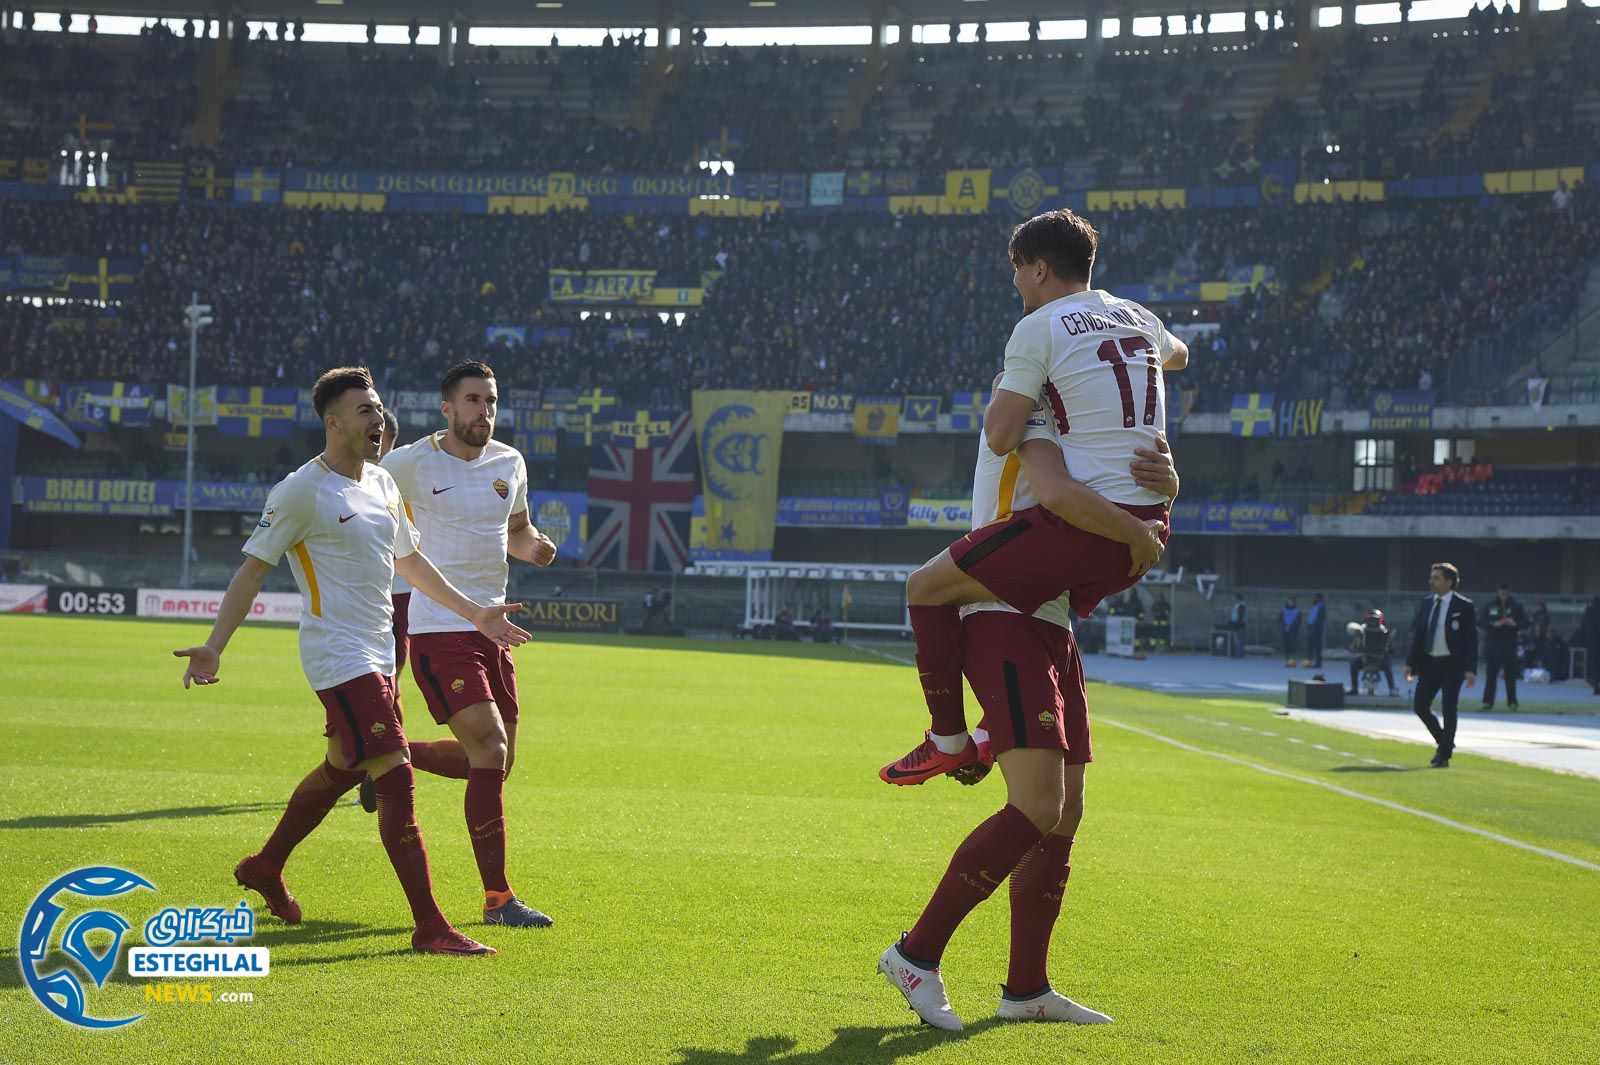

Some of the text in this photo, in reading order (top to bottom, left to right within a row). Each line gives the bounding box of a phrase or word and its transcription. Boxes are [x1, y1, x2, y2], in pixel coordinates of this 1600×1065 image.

[552, 177, 573, 193] 71
[1096, 335, 1157, 428] 17
[226, 406, 287, 417] VERONA
[618, 423, 666, 435] HELL
[59, 591, 125, 614] 00:53
[518, 600, 617, 621] SARTORI
